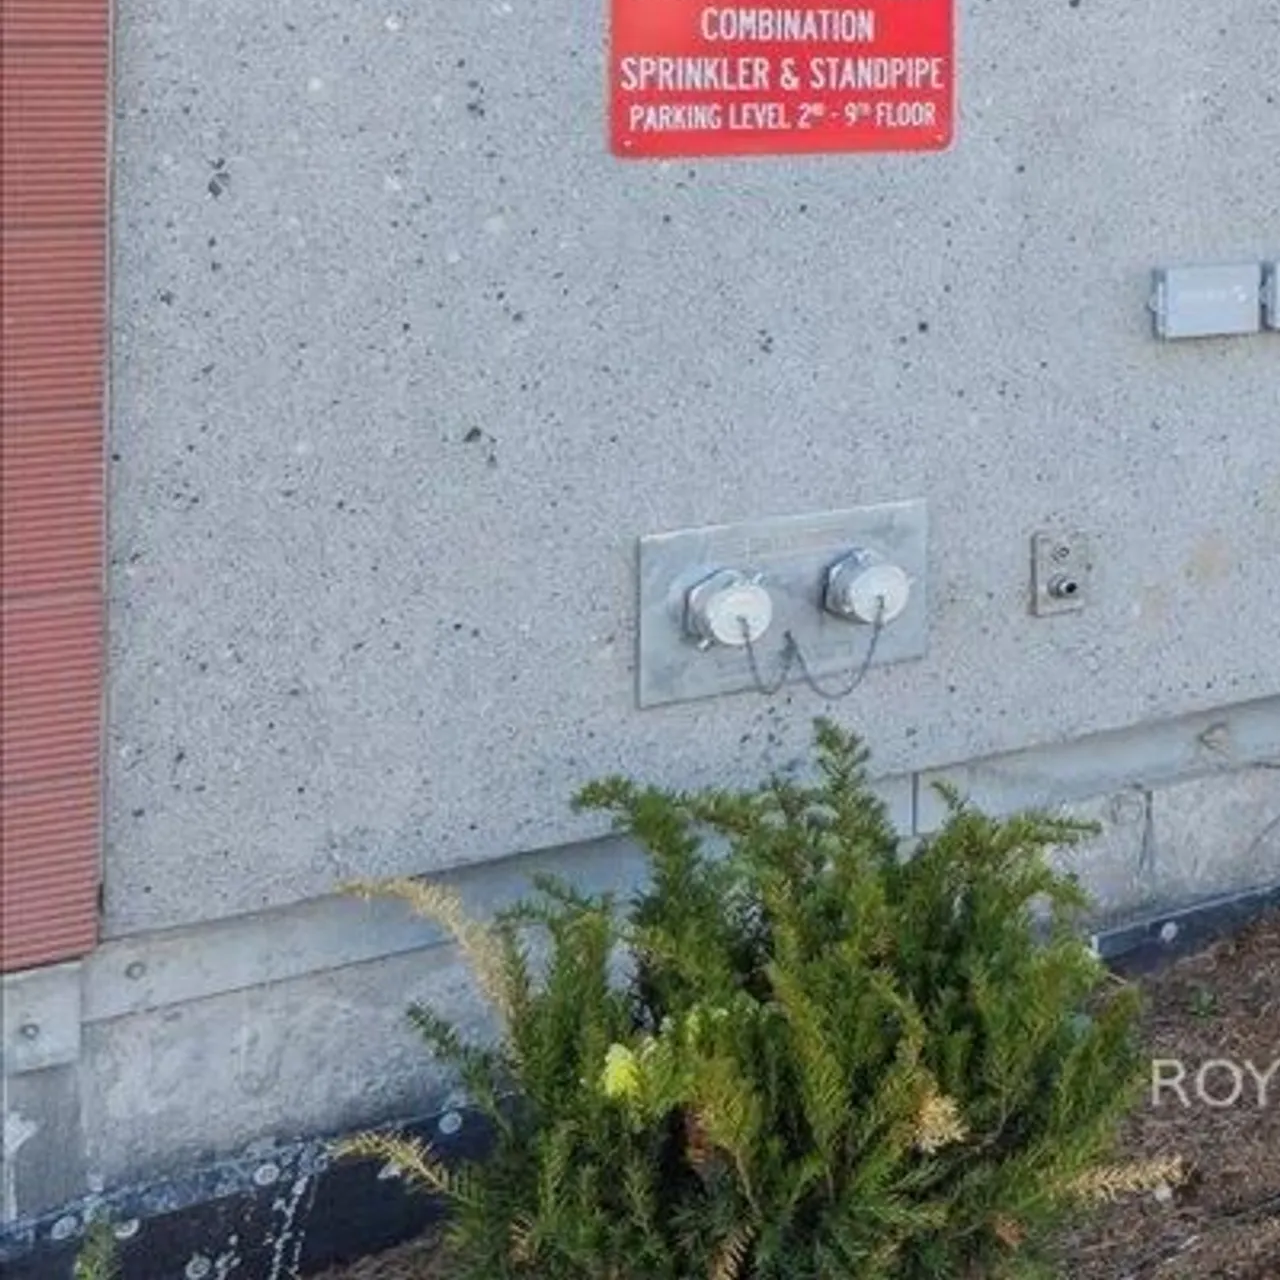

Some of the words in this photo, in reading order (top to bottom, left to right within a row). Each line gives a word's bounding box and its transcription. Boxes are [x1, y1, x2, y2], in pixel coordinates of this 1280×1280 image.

[700, 8, 875, 43] COMBINATION
[620, 57, 770, 91] SPRINKLER
[779, 57, 799, 91] &
[810, 57, 944, 90] STANDPIPE
[629, 104, 722, 131] PARKING
[729, 103, 791, 130] LEVEL
[876, 102, 936, 127] FLOOR
